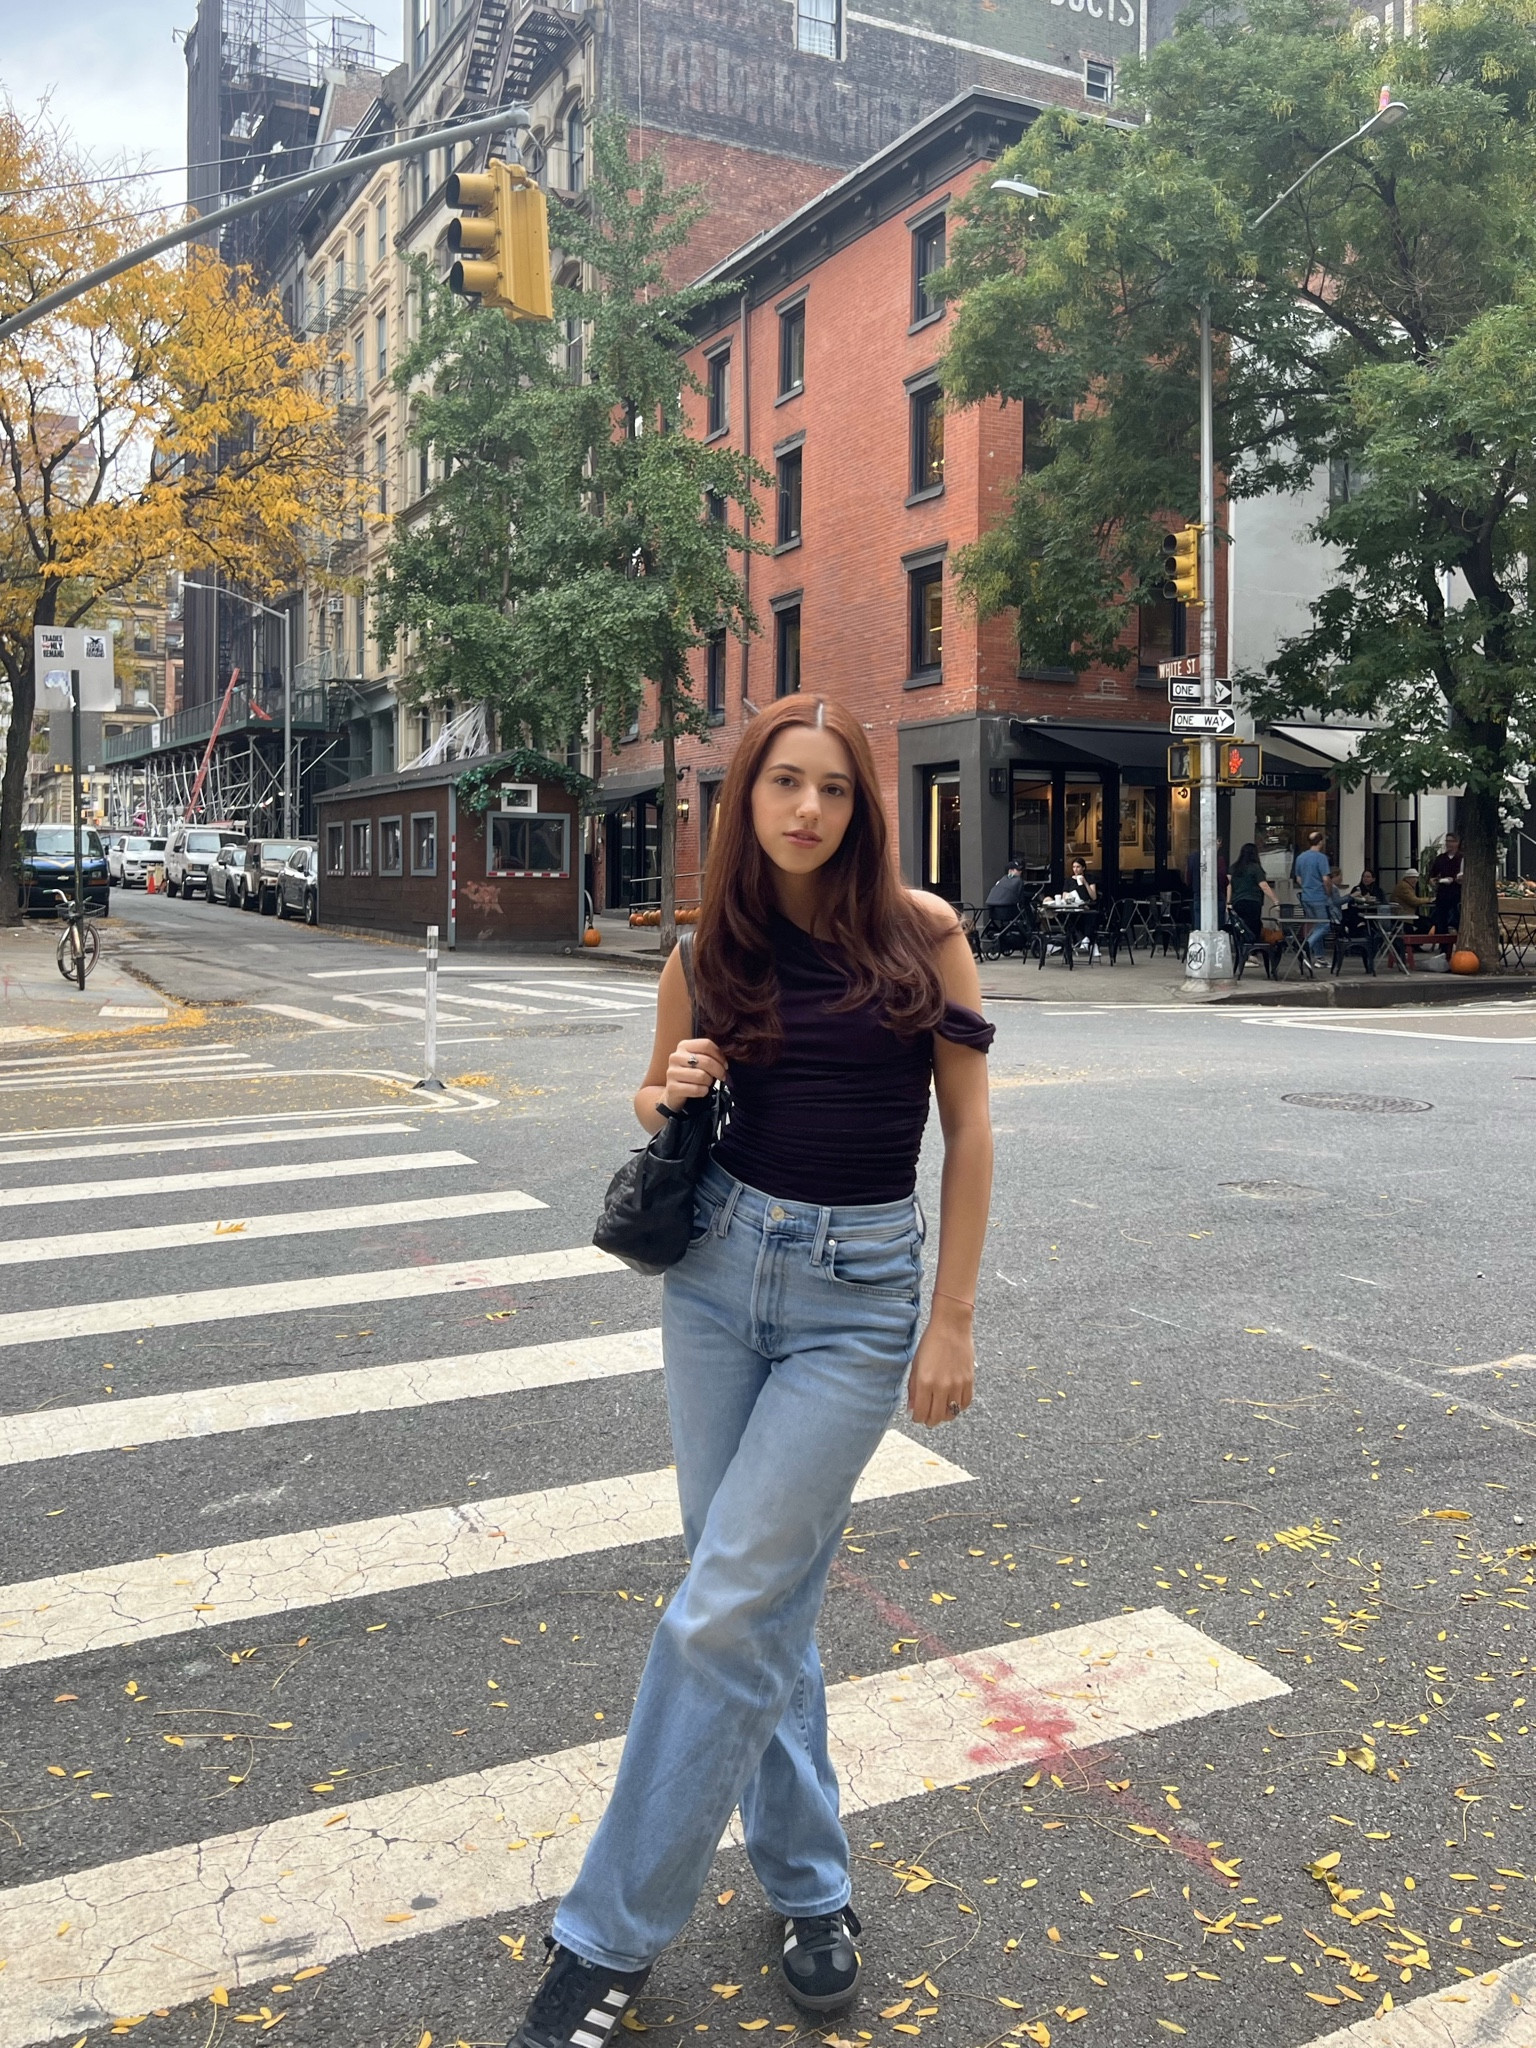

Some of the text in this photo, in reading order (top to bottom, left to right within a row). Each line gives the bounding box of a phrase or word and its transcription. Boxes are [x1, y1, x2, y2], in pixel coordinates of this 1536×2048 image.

[1159, 659, 1196, 678] WHITE ST
[1175, 684, 1194, 696] ONE
[1176, 715, 1227, 726] ONE WAY
[1244, 774, 1289, 787] REET
